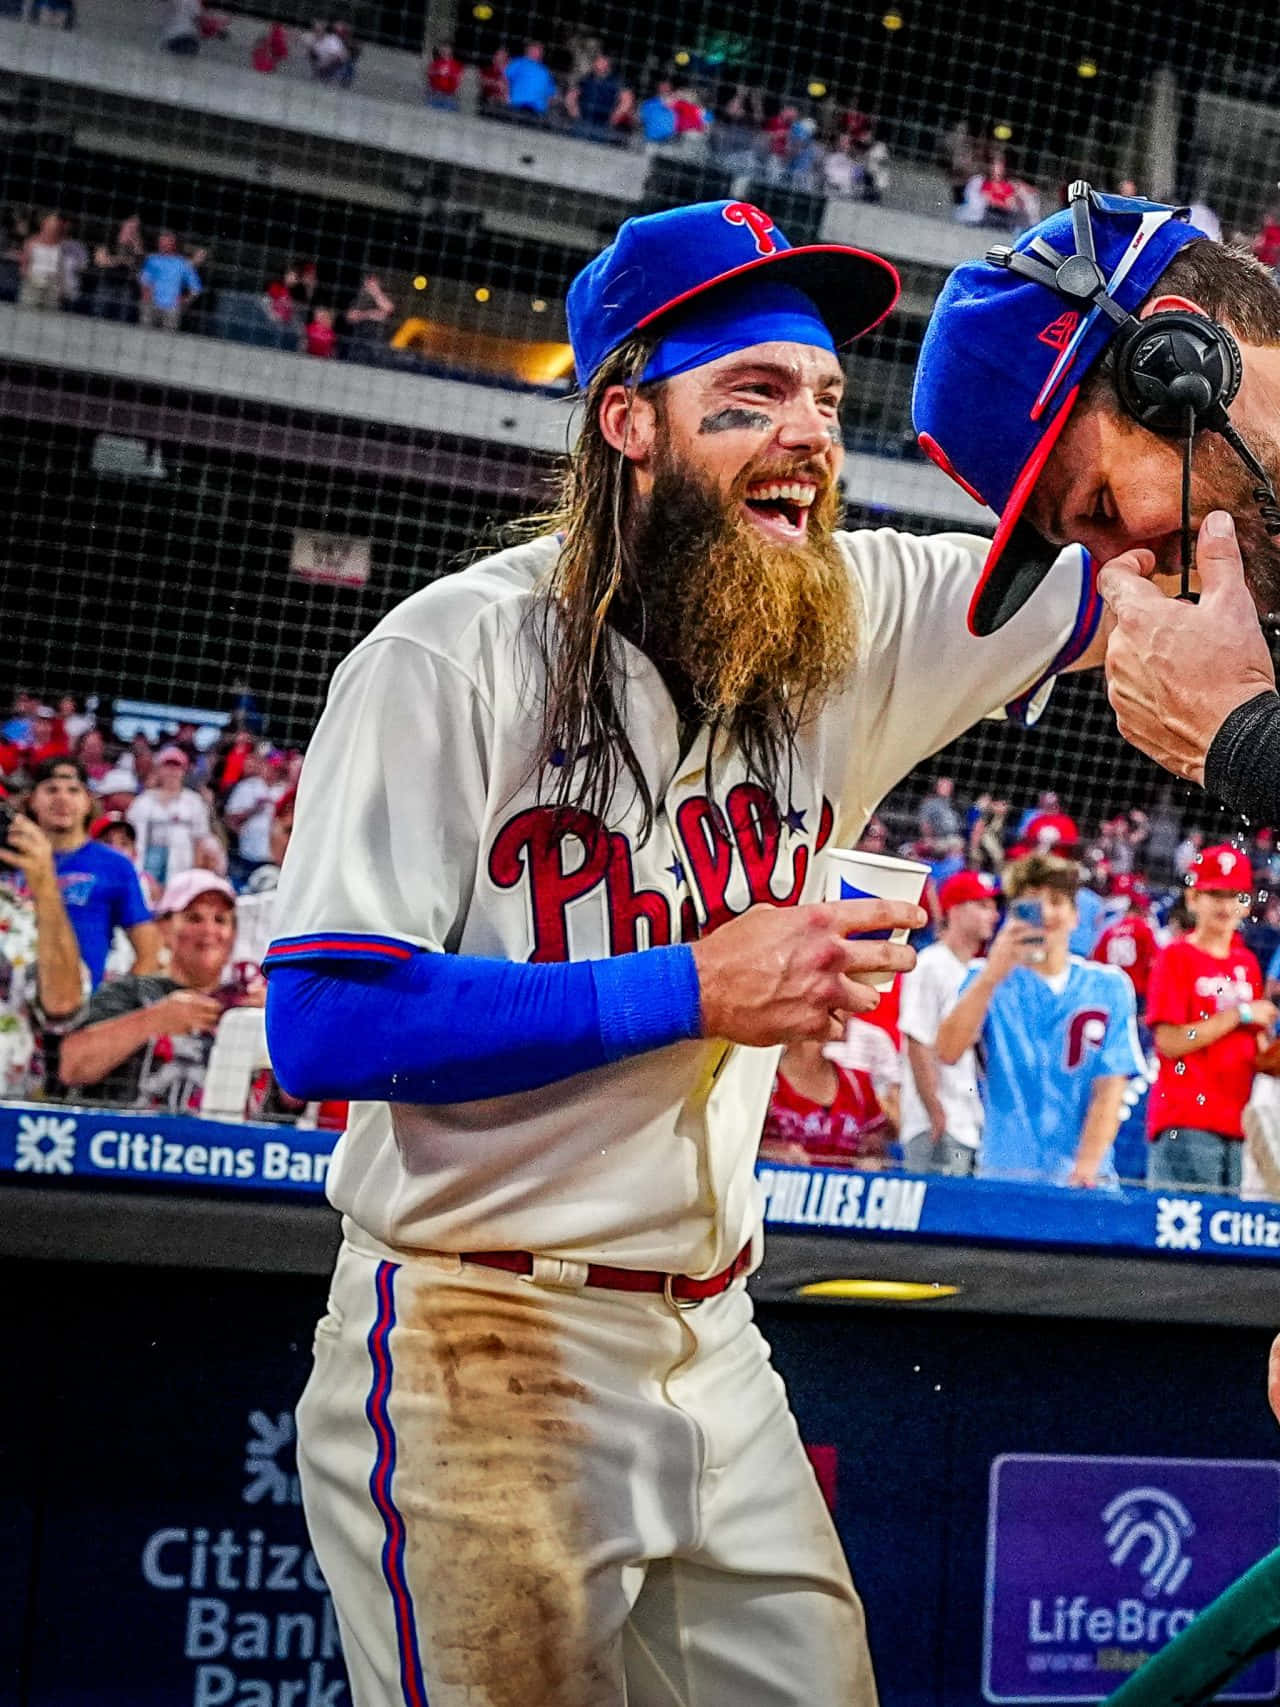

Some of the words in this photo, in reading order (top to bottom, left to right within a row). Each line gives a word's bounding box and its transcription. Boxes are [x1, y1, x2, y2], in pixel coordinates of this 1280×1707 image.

[722, 202, 776, 255] P
[1066, 1009, 1110, 1069] P
[89, 1130, 256, 1179] Citizens
[262, 1141, 332, 1184] Ban
[758, 1169, 928, 1233] PHILLIES.COM
[141, 1527, 329, 1592] Citiz
[193, 1660, 346, 1707] Park
